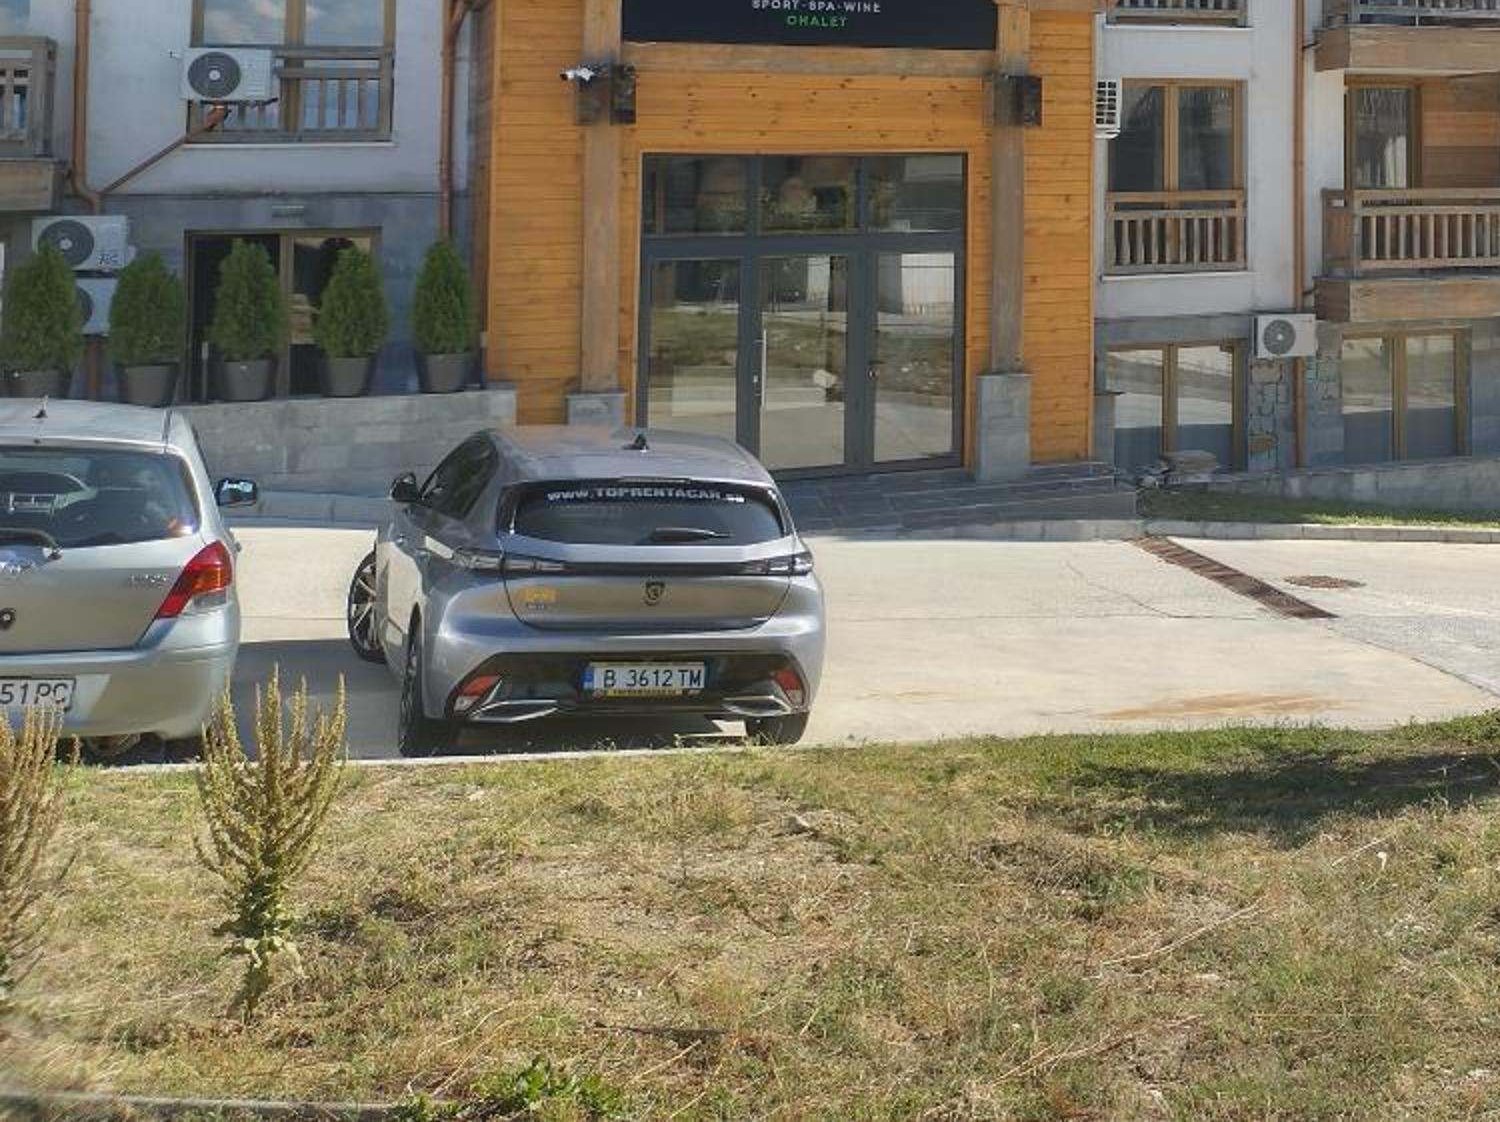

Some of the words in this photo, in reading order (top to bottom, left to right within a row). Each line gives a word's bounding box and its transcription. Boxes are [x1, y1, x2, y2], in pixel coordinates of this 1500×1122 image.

[752, 0, 799, 10] SPORT
[809, 1, 835, 11] SPA
[844, 2, 881, 13] WINE
[787, 16, 847, 27] CHALET
[604, 669, 616, 687] B
[626, 669, 673, 687] 3612
[678, 669, 702, 687] TM
